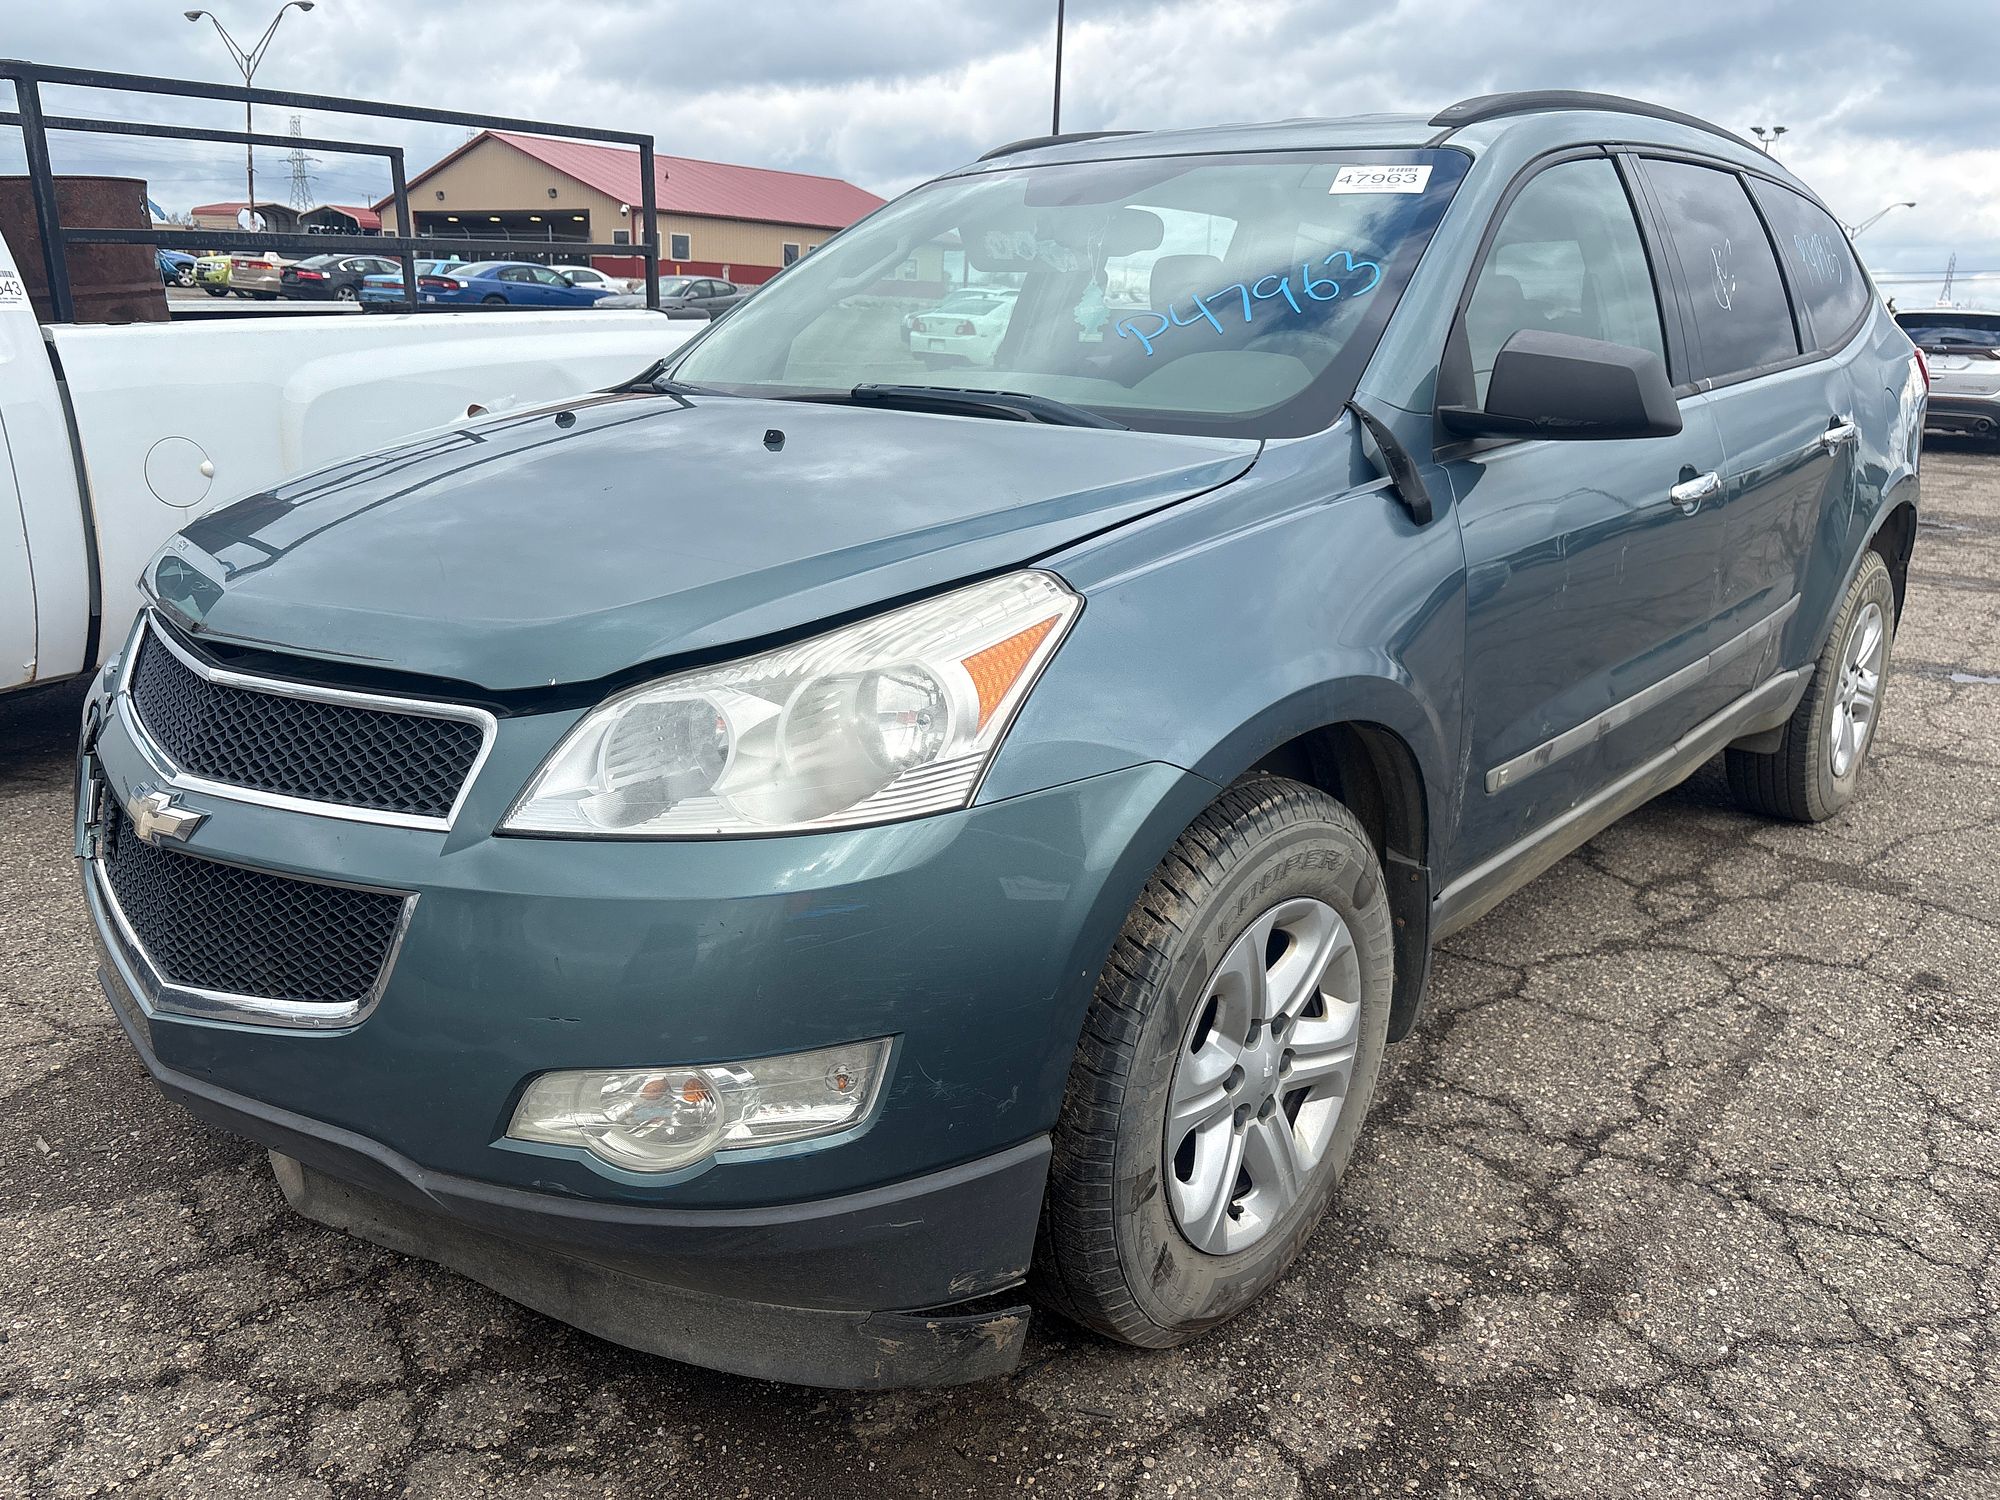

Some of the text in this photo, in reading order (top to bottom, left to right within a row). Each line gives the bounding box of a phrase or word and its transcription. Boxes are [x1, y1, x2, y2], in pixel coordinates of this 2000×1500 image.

[1338, 173, 1417, 184] 47963
[1115, 251, 1381, 356] P47963
[1218, 849, 1343, 942] COOPER
